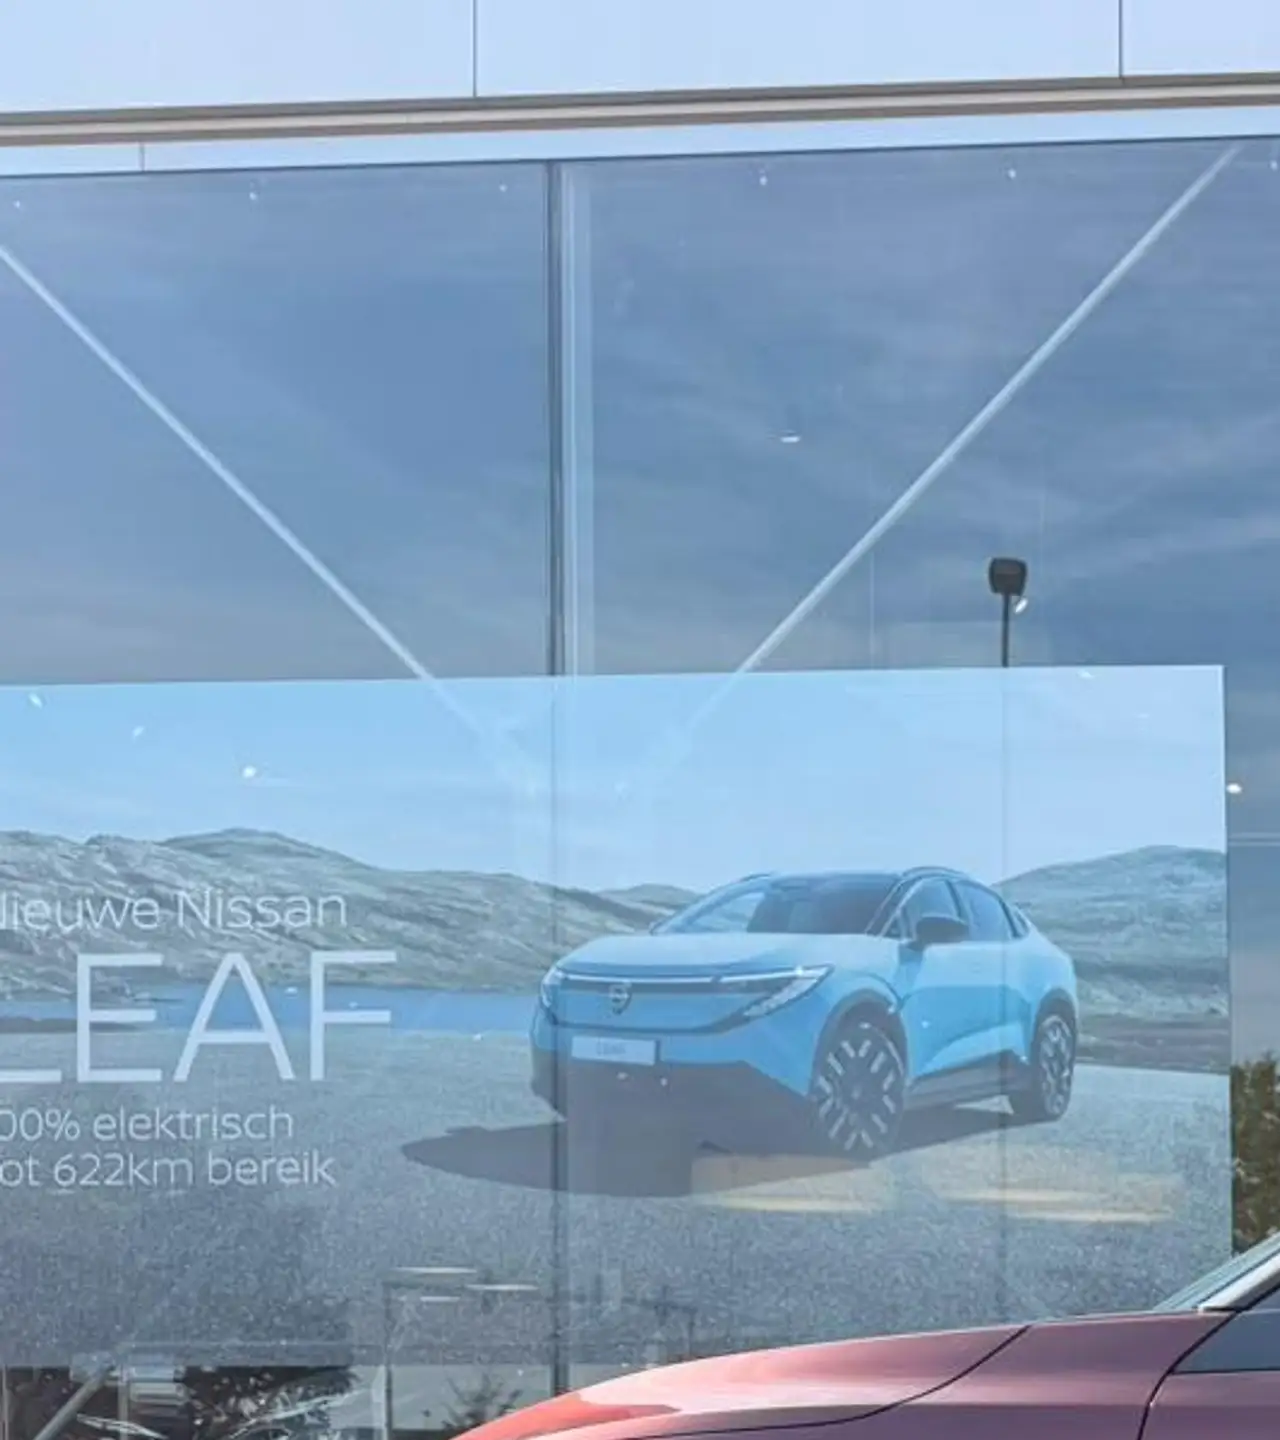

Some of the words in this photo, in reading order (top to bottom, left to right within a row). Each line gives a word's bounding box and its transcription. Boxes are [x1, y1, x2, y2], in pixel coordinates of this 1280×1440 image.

[177, 888, 347, 929] Nissan
[93, 1104, 294, 1142] elektrisch
[54, 1151, 194, 1187] 622km
[207, 1149, 338, 1187] bereik
